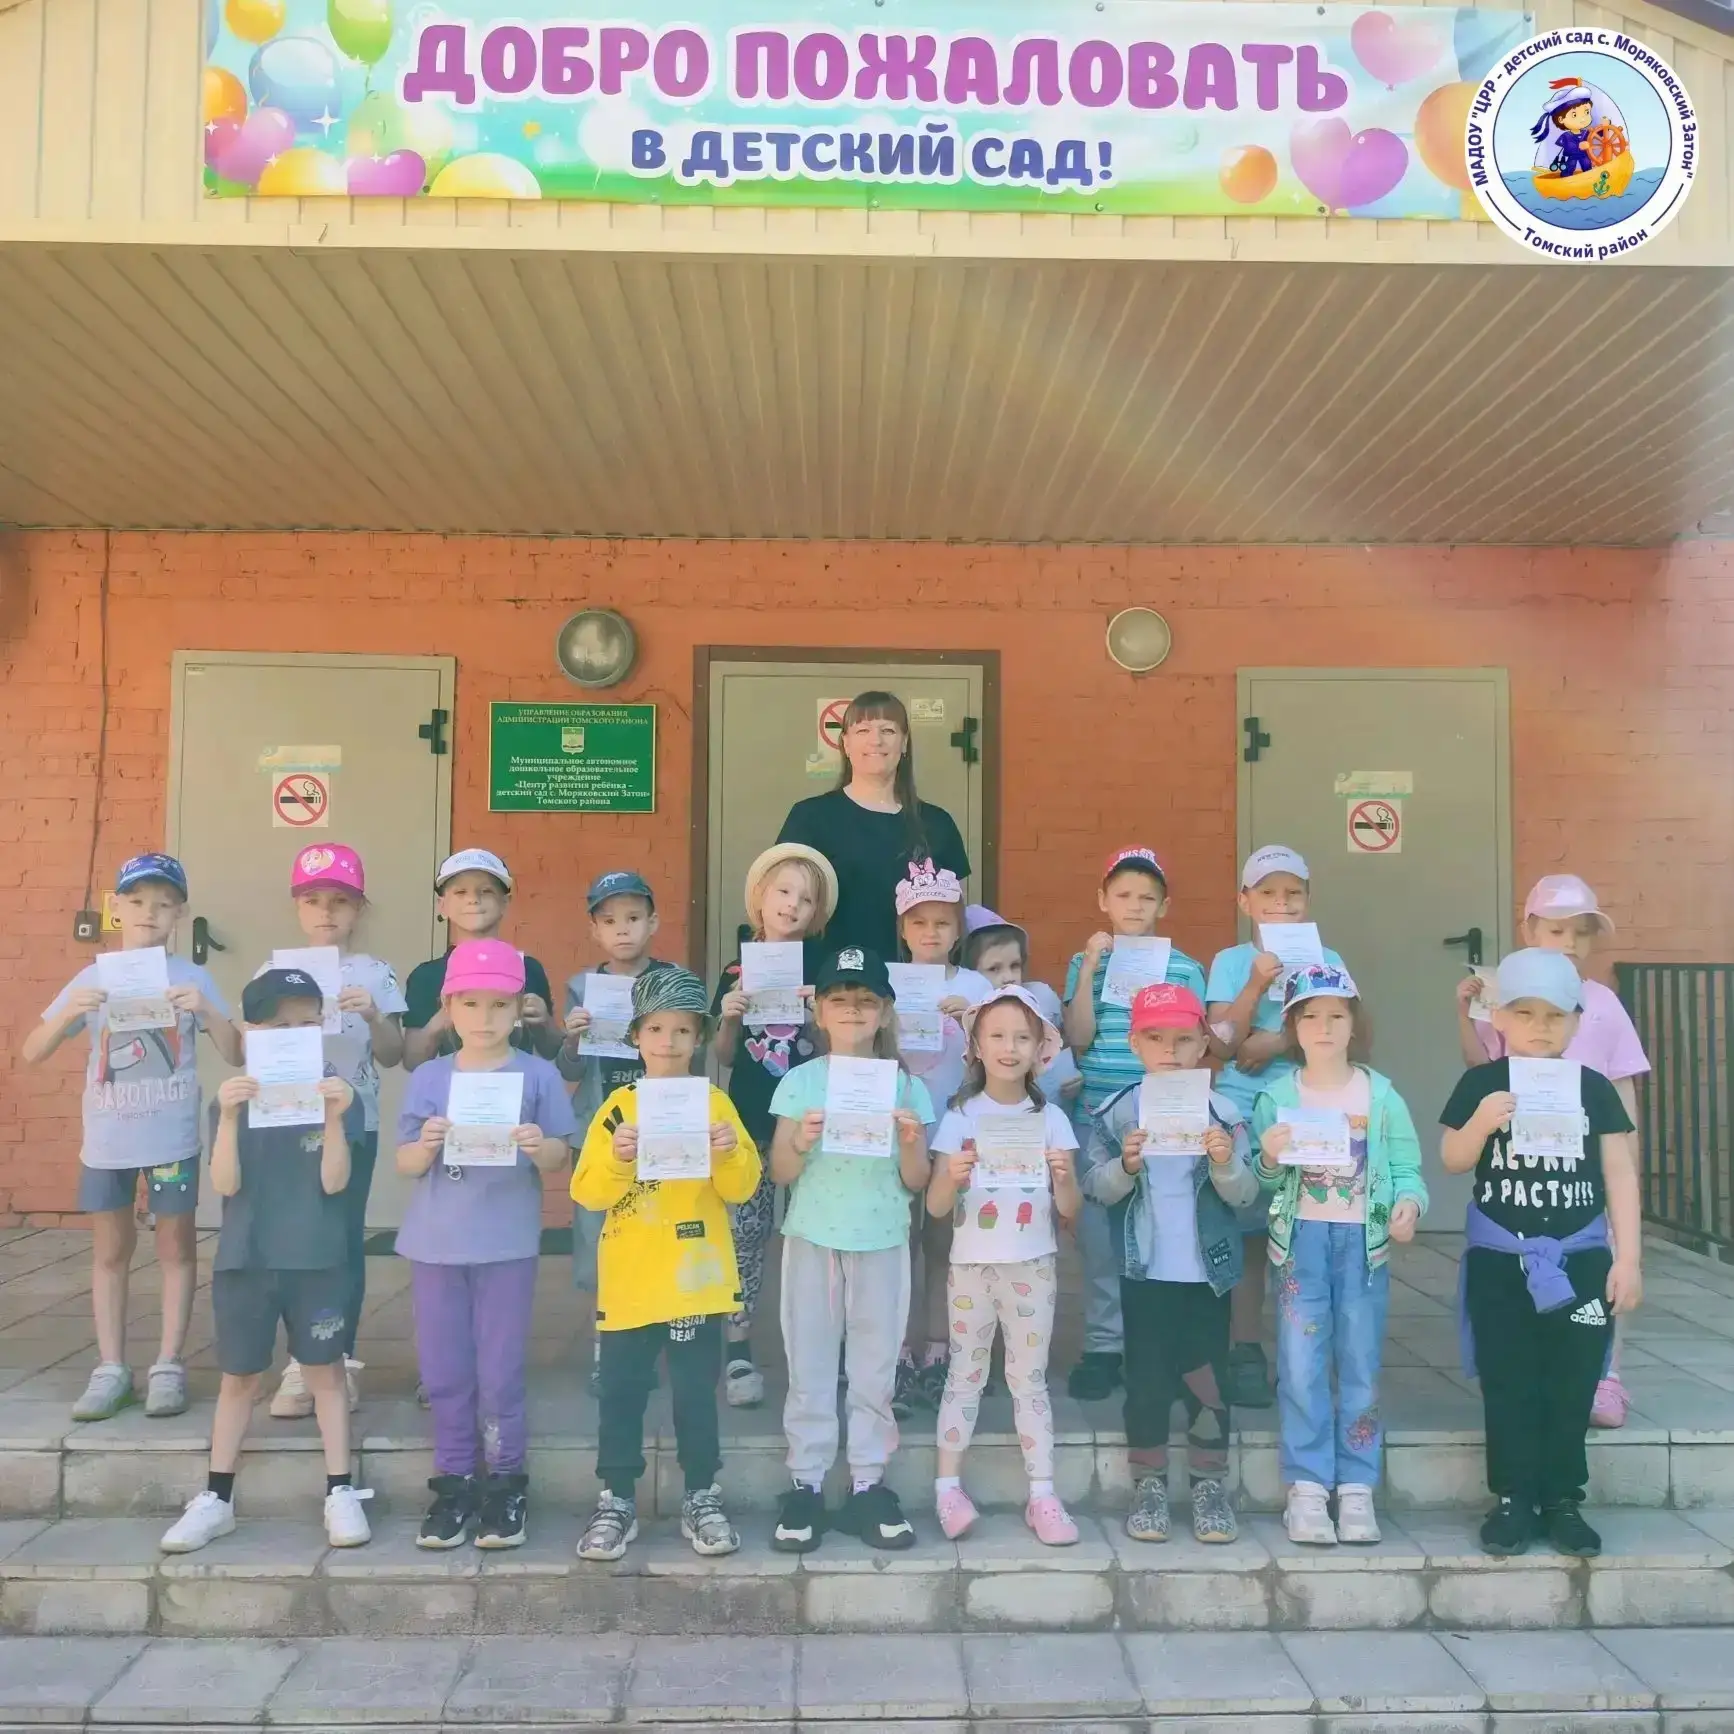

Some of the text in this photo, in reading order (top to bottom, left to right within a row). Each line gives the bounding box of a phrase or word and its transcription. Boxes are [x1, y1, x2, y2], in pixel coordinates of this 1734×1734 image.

[403, 24, 1348, 112] ДОБРО ПОЖАЛОВАТЬ
[631, 123, 1113, 186] В ДЕТСКИЙ САД!
[497, 716, 569, 724] АДМИНИСТРАЦИИ
[511, 756, 584, 766] Муниципальное
[566, 765, 639, 774] образовательное
[547, 774, 601, 782] учреждение
[549, 782, 589, 790] развития
[558, 789, 619, 798] Моряковский
[580, 797, 611, 806] района
[92, 1075, 188, 1110] SABOTAGE
[1501, 1179, 1594, 1209] РАСТУ!!!
[668, 1315, 706, 1328] USSIAN
[1570, 1313, 1607, 1325] adidas
[670, 1328, 696, 1342] BEAR
